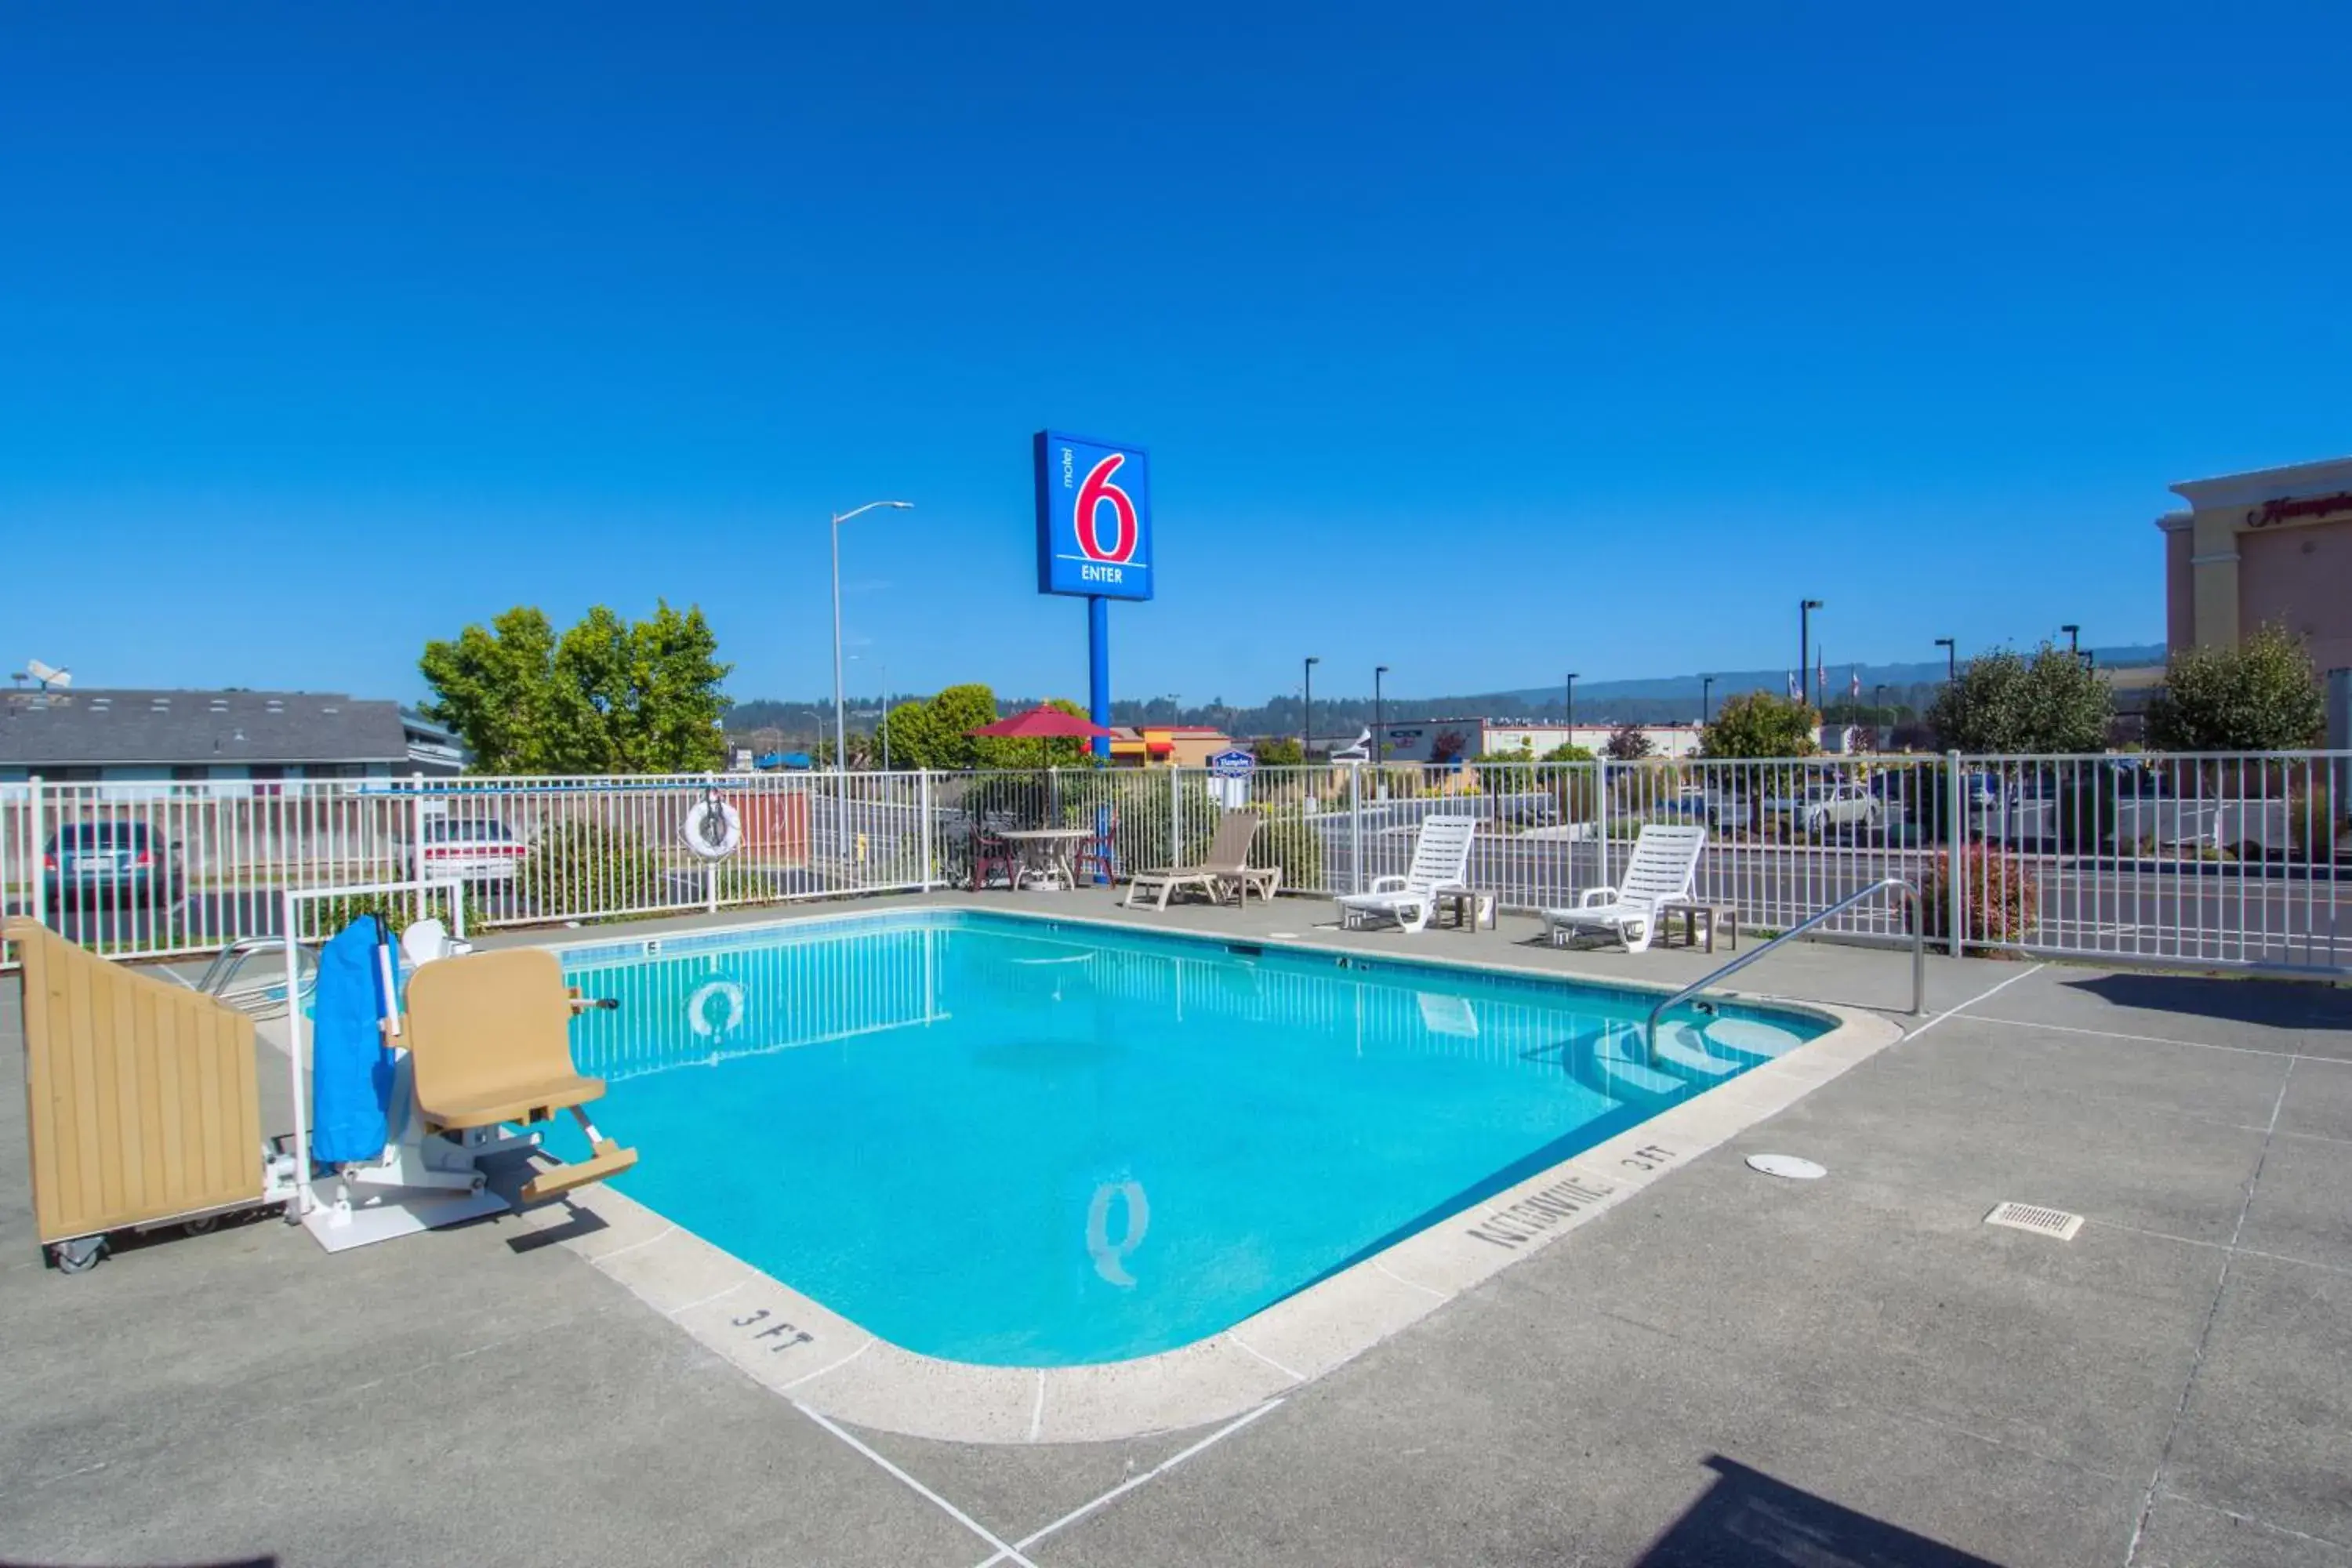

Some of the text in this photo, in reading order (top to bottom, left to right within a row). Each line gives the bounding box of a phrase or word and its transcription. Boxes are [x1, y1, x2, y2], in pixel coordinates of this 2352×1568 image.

[1061, 448, 1138, 564] motel 6
[1081, 564, 1123, 584] ENTER
[1621, 1145, 1677, 1171] 3 FT
[732, 1309, 814, 1352] 3 FT
